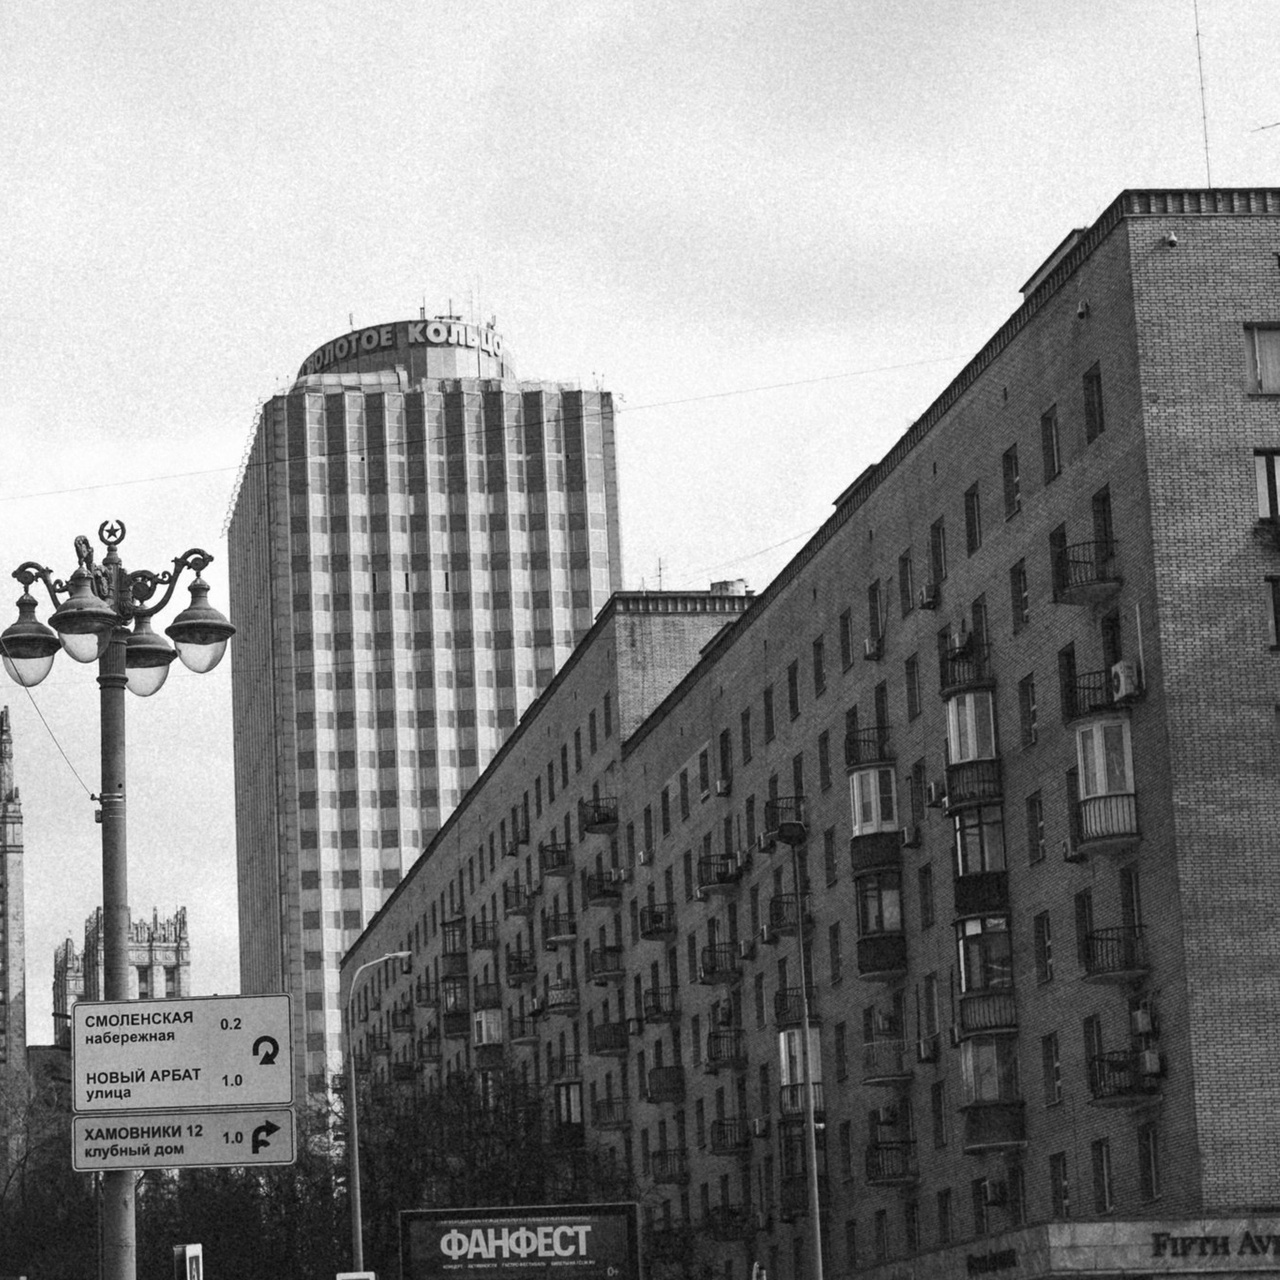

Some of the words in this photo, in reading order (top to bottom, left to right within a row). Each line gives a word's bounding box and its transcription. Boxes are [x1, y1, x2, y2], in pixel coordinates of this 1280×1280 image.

[408, 322, 504, 358] КОЛЬЦО
[85, 1011, 194, 1028] СМОЛЕНСКАЯ
[220, 1018, 243, 1031] 0.2
[85, 1031, 176, 1046] набережная
[86, 1069, 146, 1085] НОВЫЙ
[150, 1068, 202, 1083] АРБАТ
[222, 1074, 243, 1087] 1.0
[86, 1087, 132, 1103] улица
[84, 1125, 183, 1142] ХАМОВНИКИ
[186, 1124, 204, 1138] 12
[223, 1131, 245, 1145] 1.0
[84, 1144, 151, 1160] клубный
[154, 1144, 185, 1158] дом
[440, 1225, 592, 1260] ФАНФЕСТ
